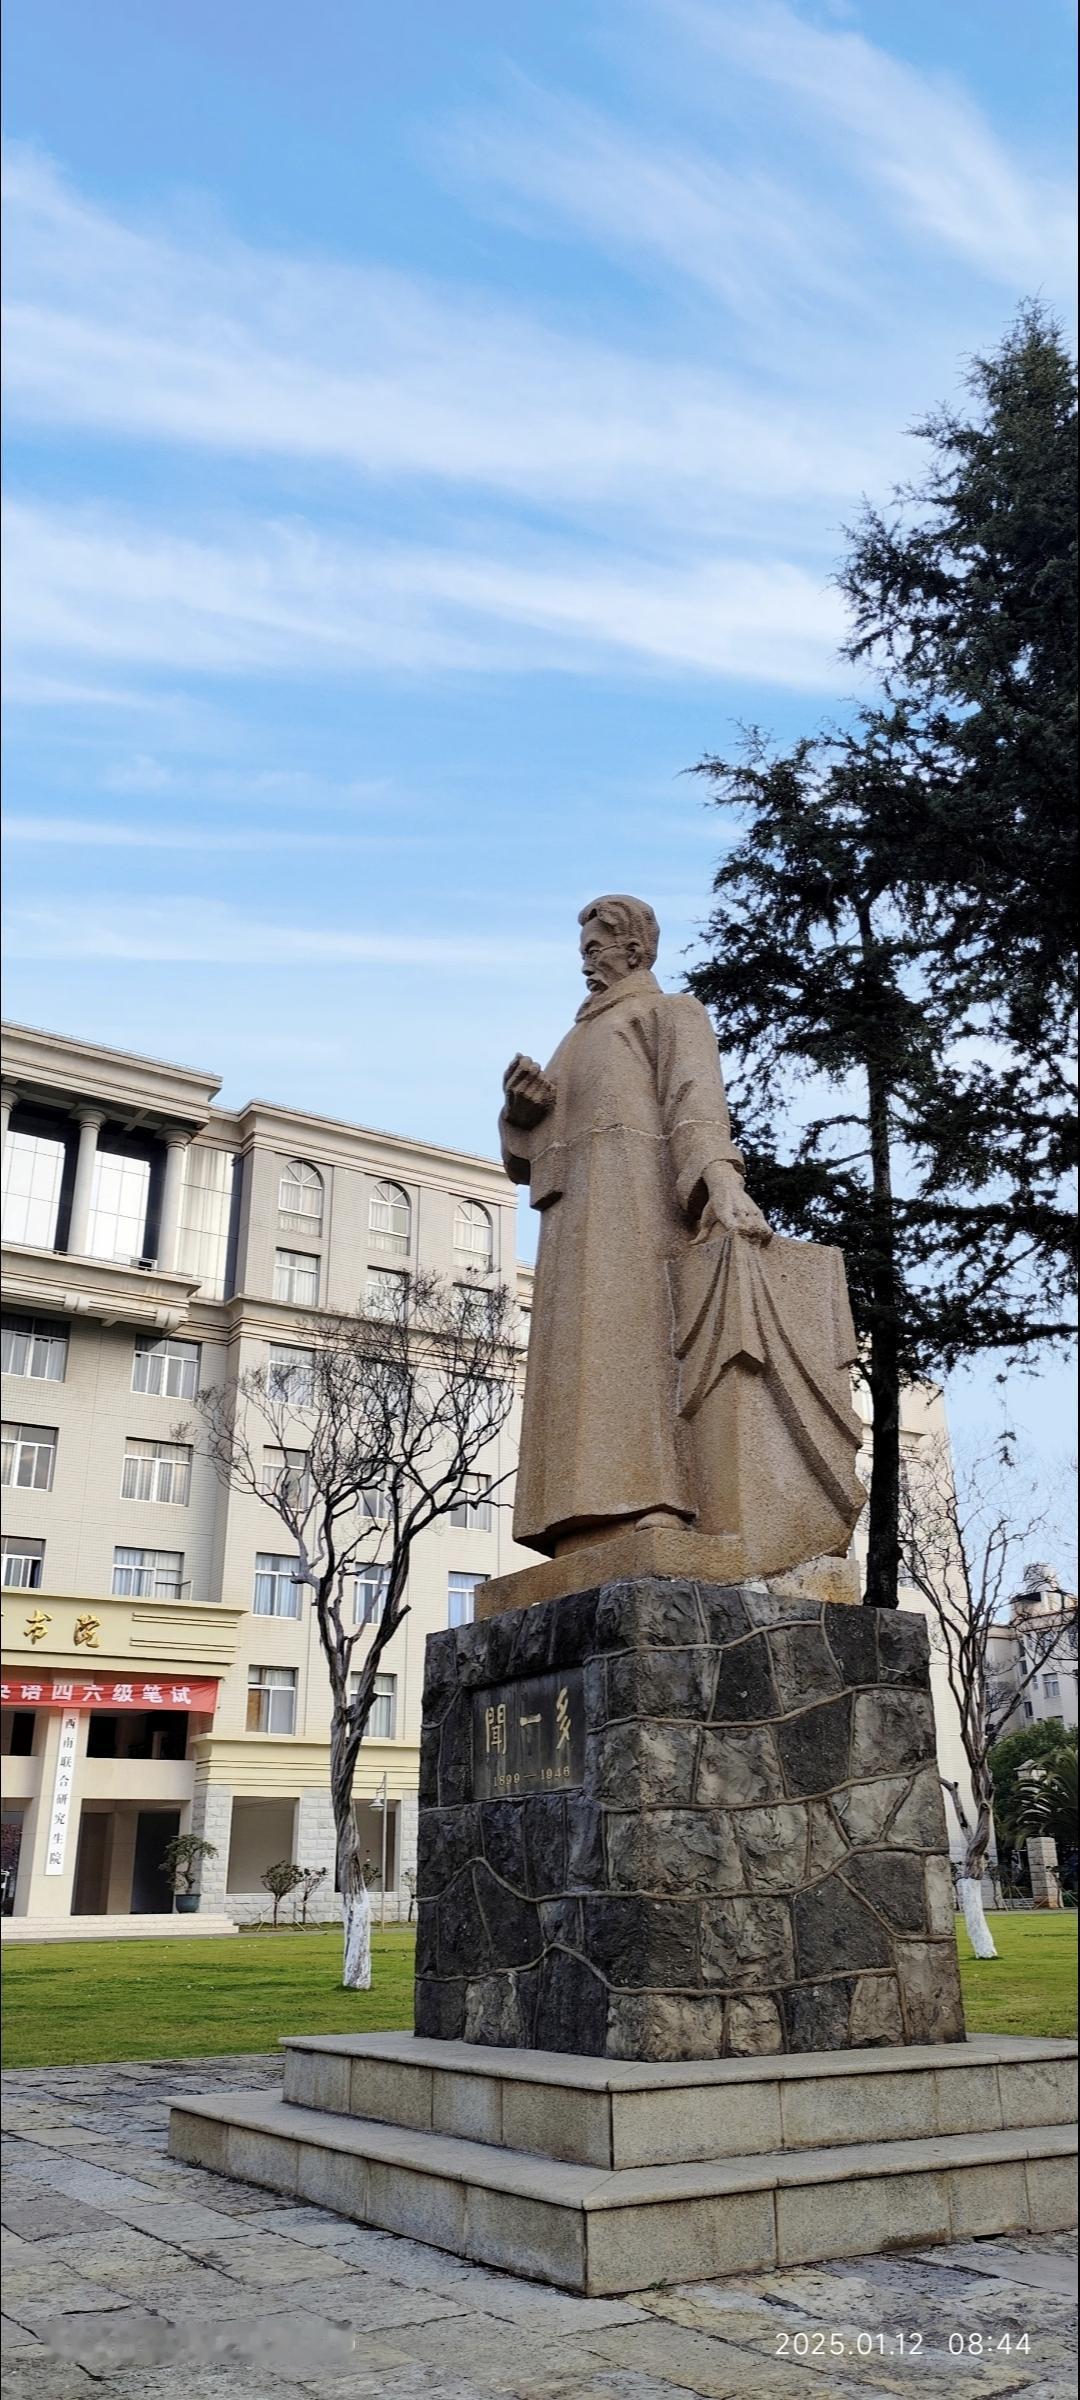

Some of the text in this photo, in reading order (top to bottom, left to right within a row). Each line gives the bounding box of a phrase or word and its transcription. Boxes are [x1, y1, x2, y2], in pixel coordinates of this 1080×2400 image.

[49, 1717, 76, 1865] 西南联合研究生院
